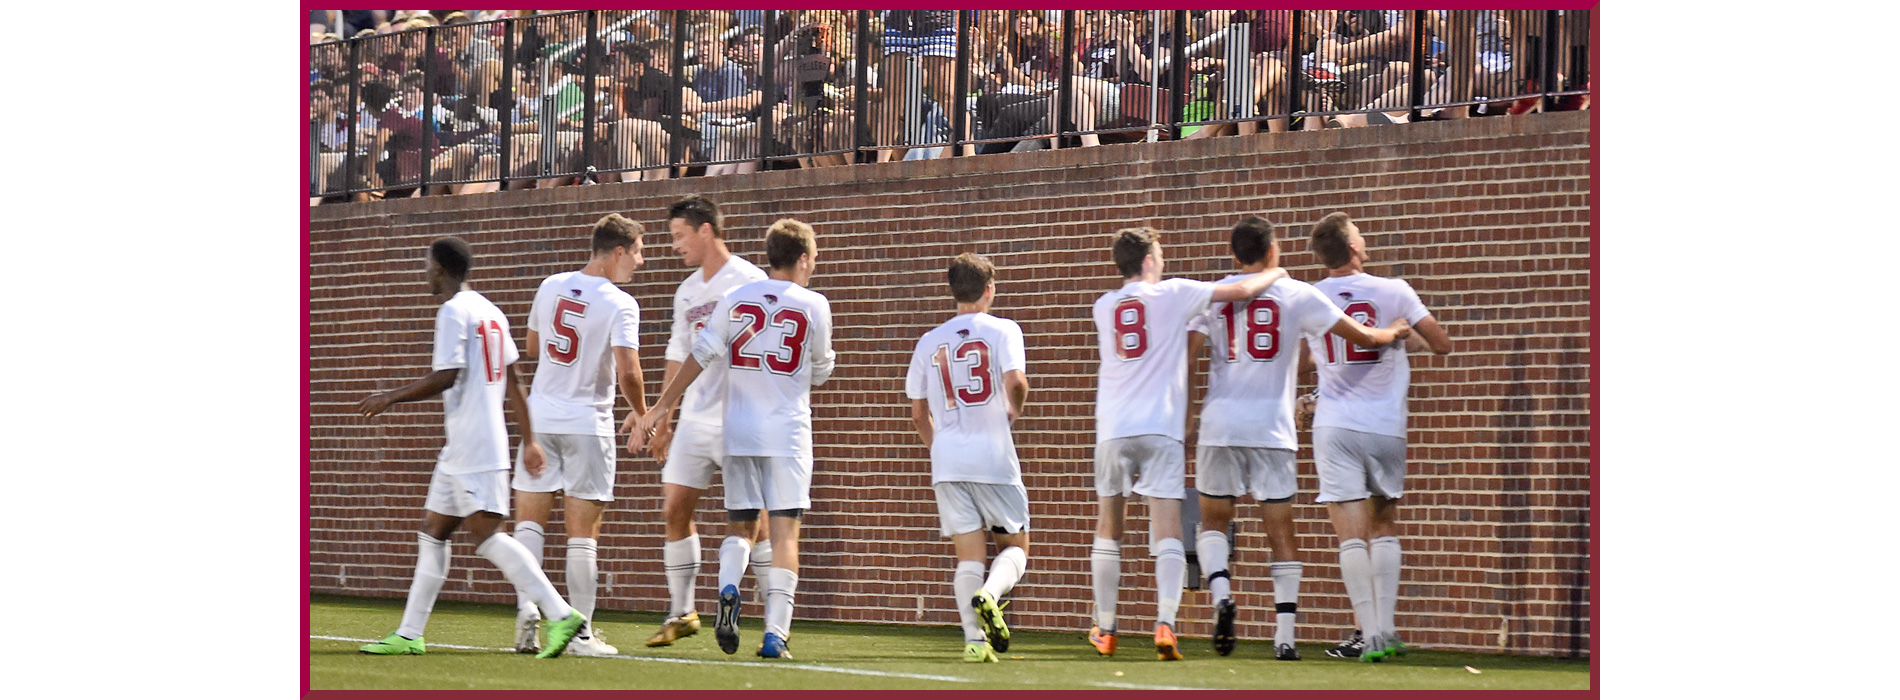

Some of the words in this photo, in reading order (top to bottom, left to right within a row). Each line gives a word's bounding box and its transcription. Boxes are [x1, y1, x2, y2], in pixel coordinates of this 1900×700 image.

[545, 295, 590, 367] 5
[728, 300, 811, 377] 23
[1113, 296, 1151, 362] 8
[1217, 296, 1282, 363] 18
[930, 338, 996, 412] 13
